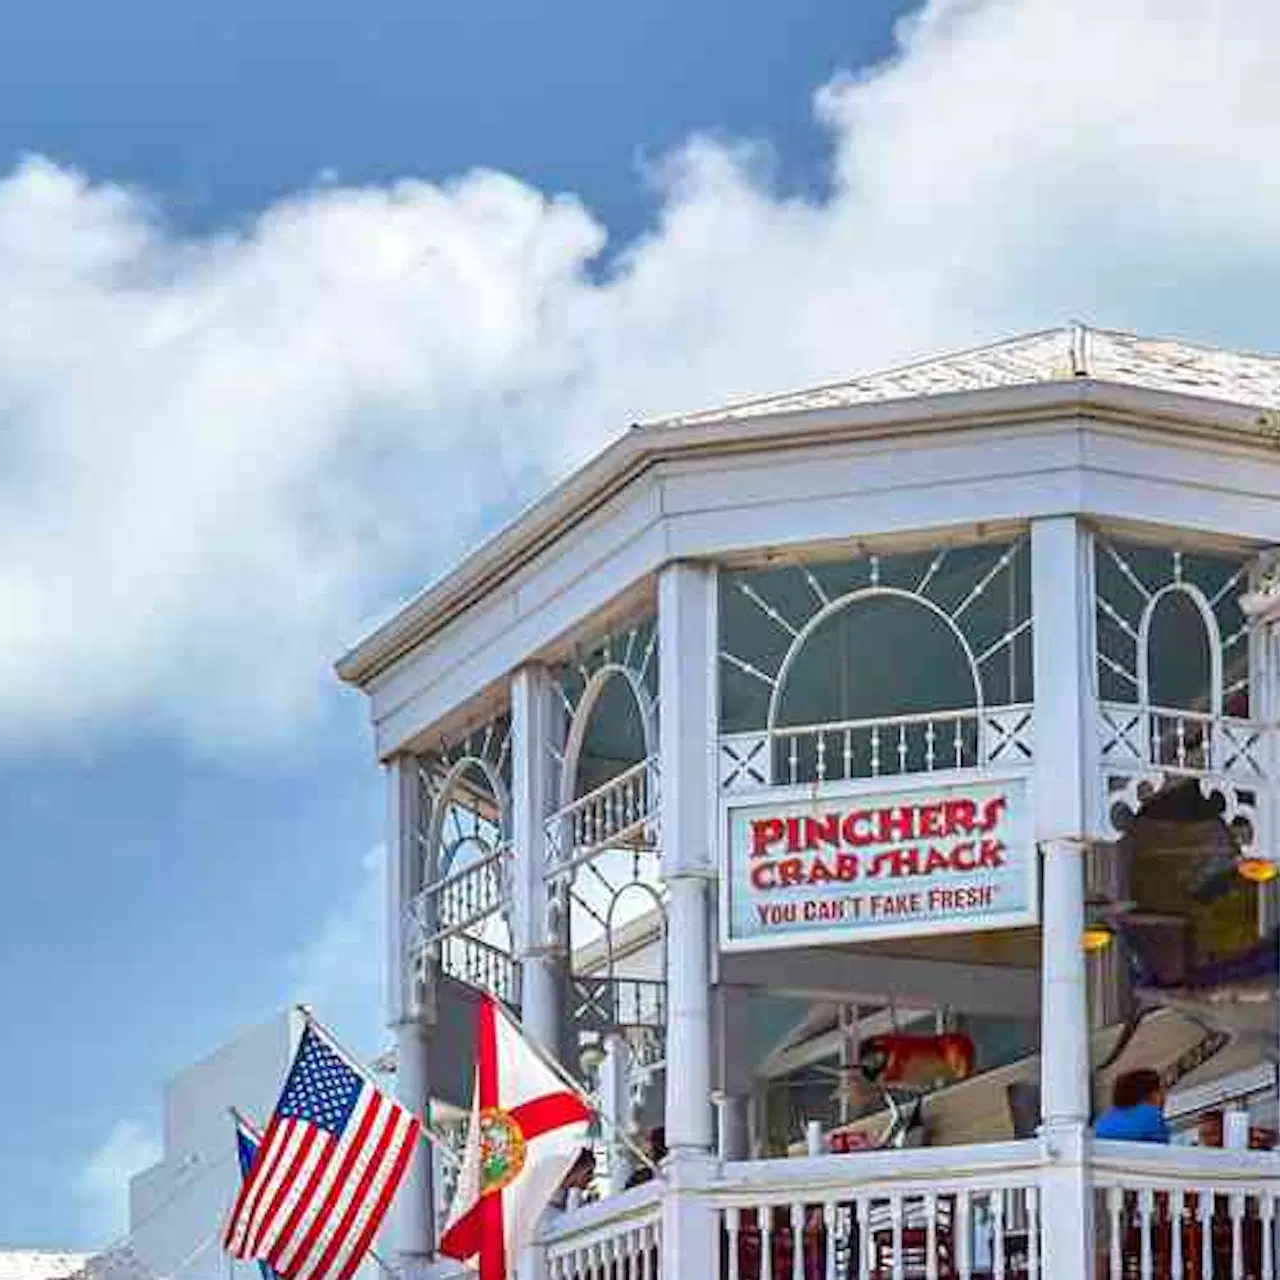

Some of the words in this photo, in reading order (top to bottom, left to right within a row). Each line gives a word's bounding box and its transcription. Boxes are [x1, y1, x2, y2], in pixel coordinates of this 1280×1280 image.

[749, 794, 1006, 856] PINCHERS
[750, 853, 857, 890] CRAB
[867, 840, 1006, 877] SHACK
[758, 901, 799, 925] YOU
[804, 896, 862, 921] CAN'T
[871, 893, 920, 917] FAKE
